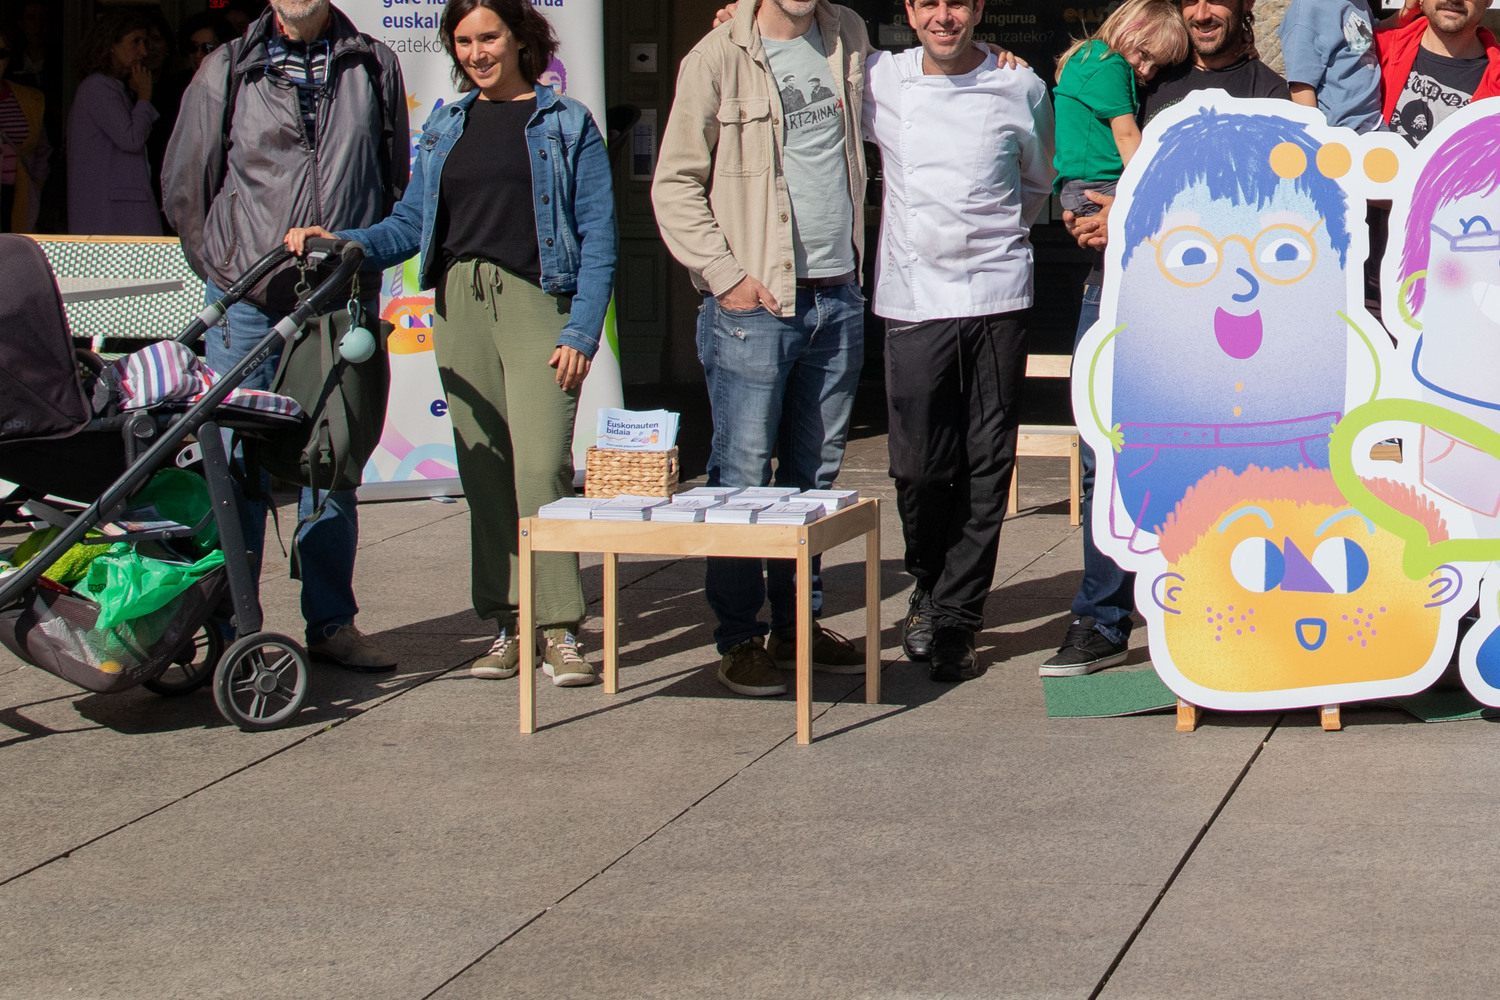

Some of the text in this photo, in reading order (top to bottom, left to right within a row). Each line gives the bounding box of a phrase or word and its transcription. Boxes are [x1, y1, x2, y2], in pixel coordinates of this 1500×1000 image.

[382, 11, 439, 29] euskal
[984, 11, 1037, 27] ingurua
[1000, 30, 1055, 43] izateko?
[242, 345, 271, 378] CRUZ
[606, 419, 659, 430] Euskonauten
[606, 427, 631, 436] bidaia
